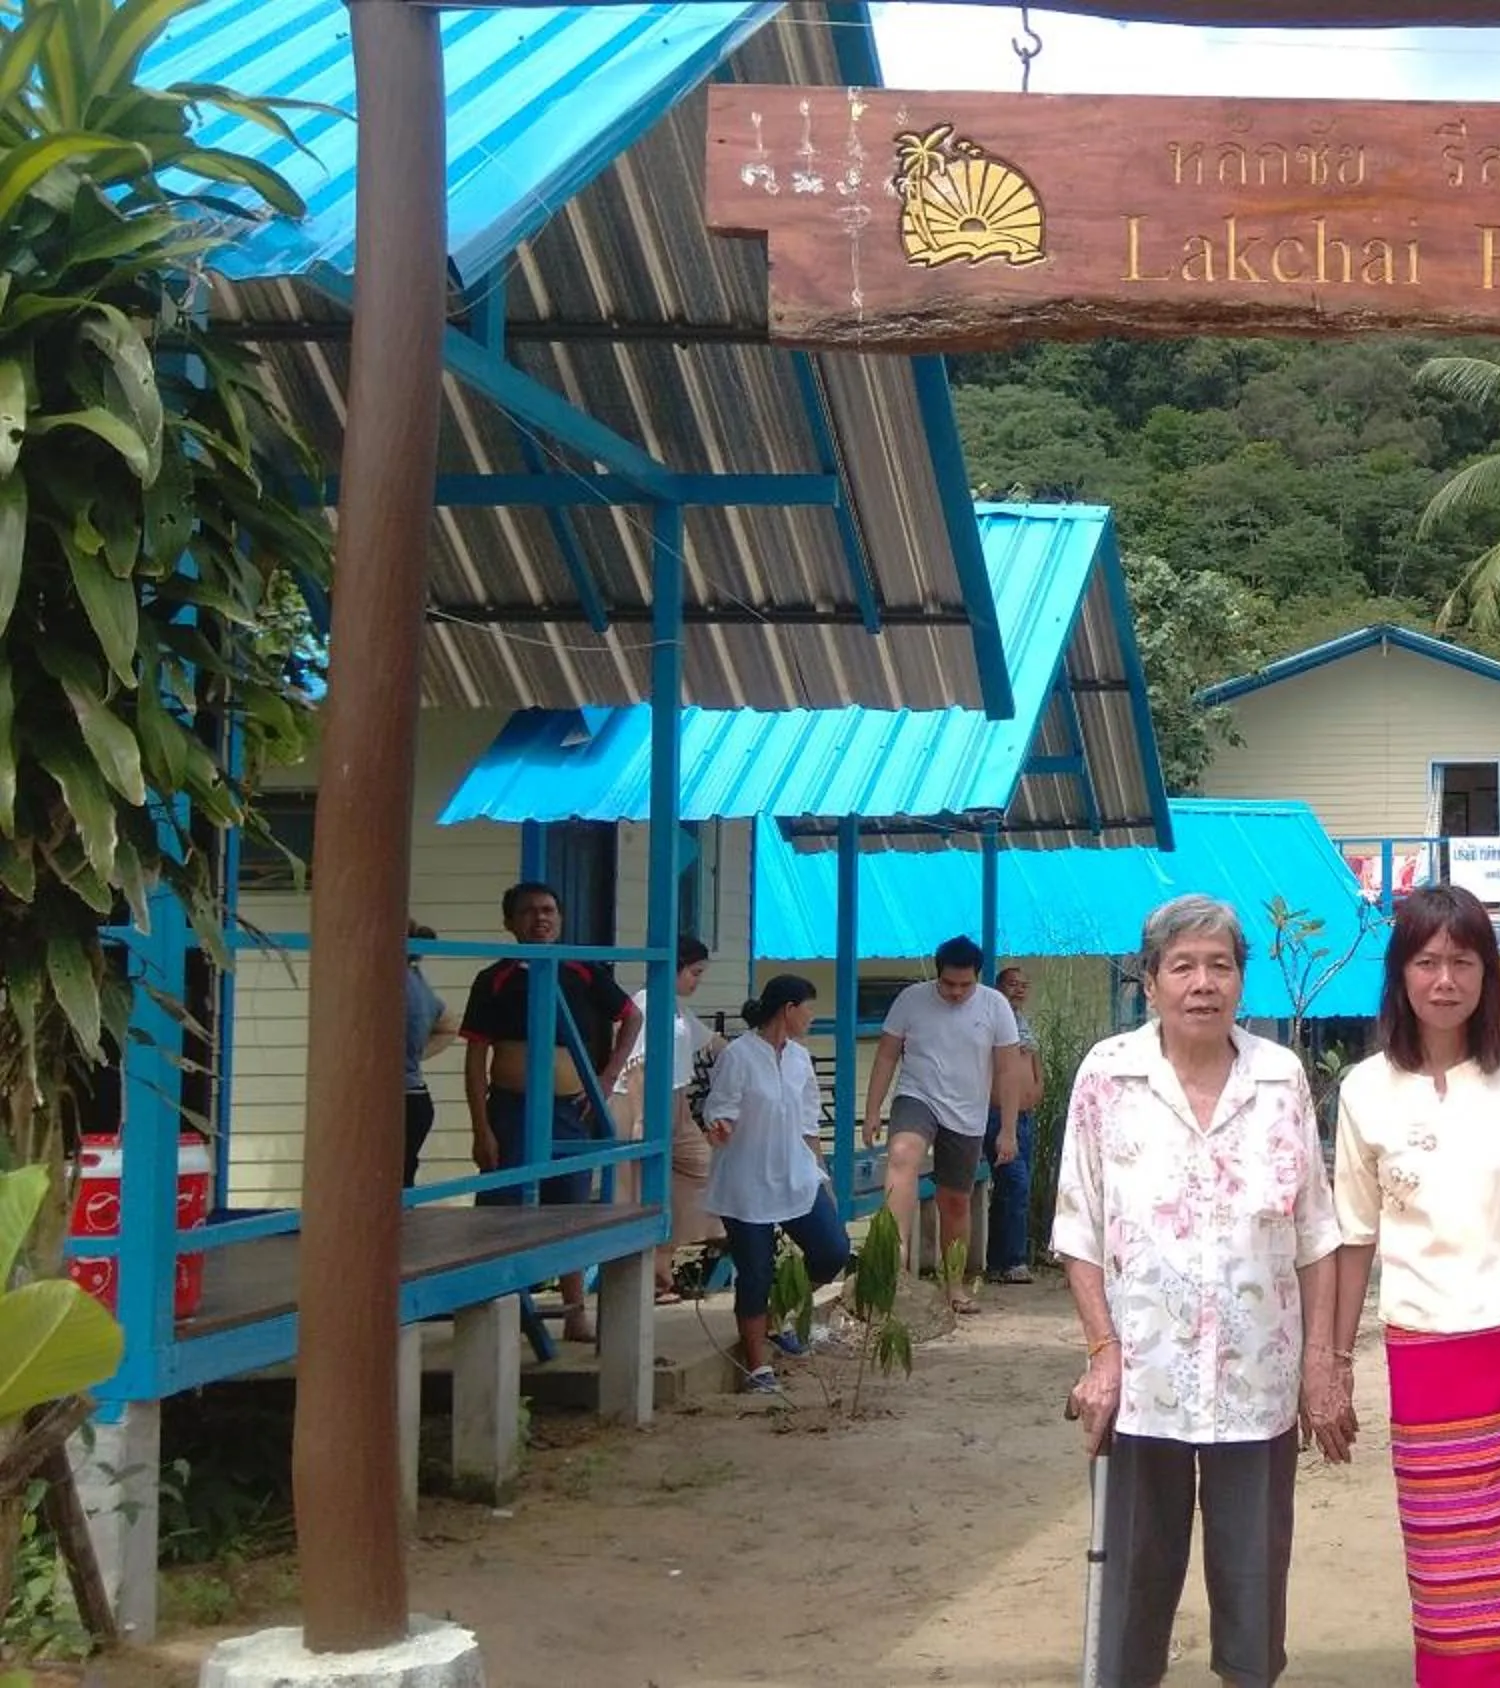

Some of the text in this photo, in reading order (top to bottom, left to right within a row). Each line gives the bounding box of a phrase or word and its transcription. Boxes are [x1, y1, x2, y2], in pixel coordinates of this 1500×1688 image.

[1167, 111, 1367, 186] หลักชัย
[1119, 212, 1422, 285] Lakchai
